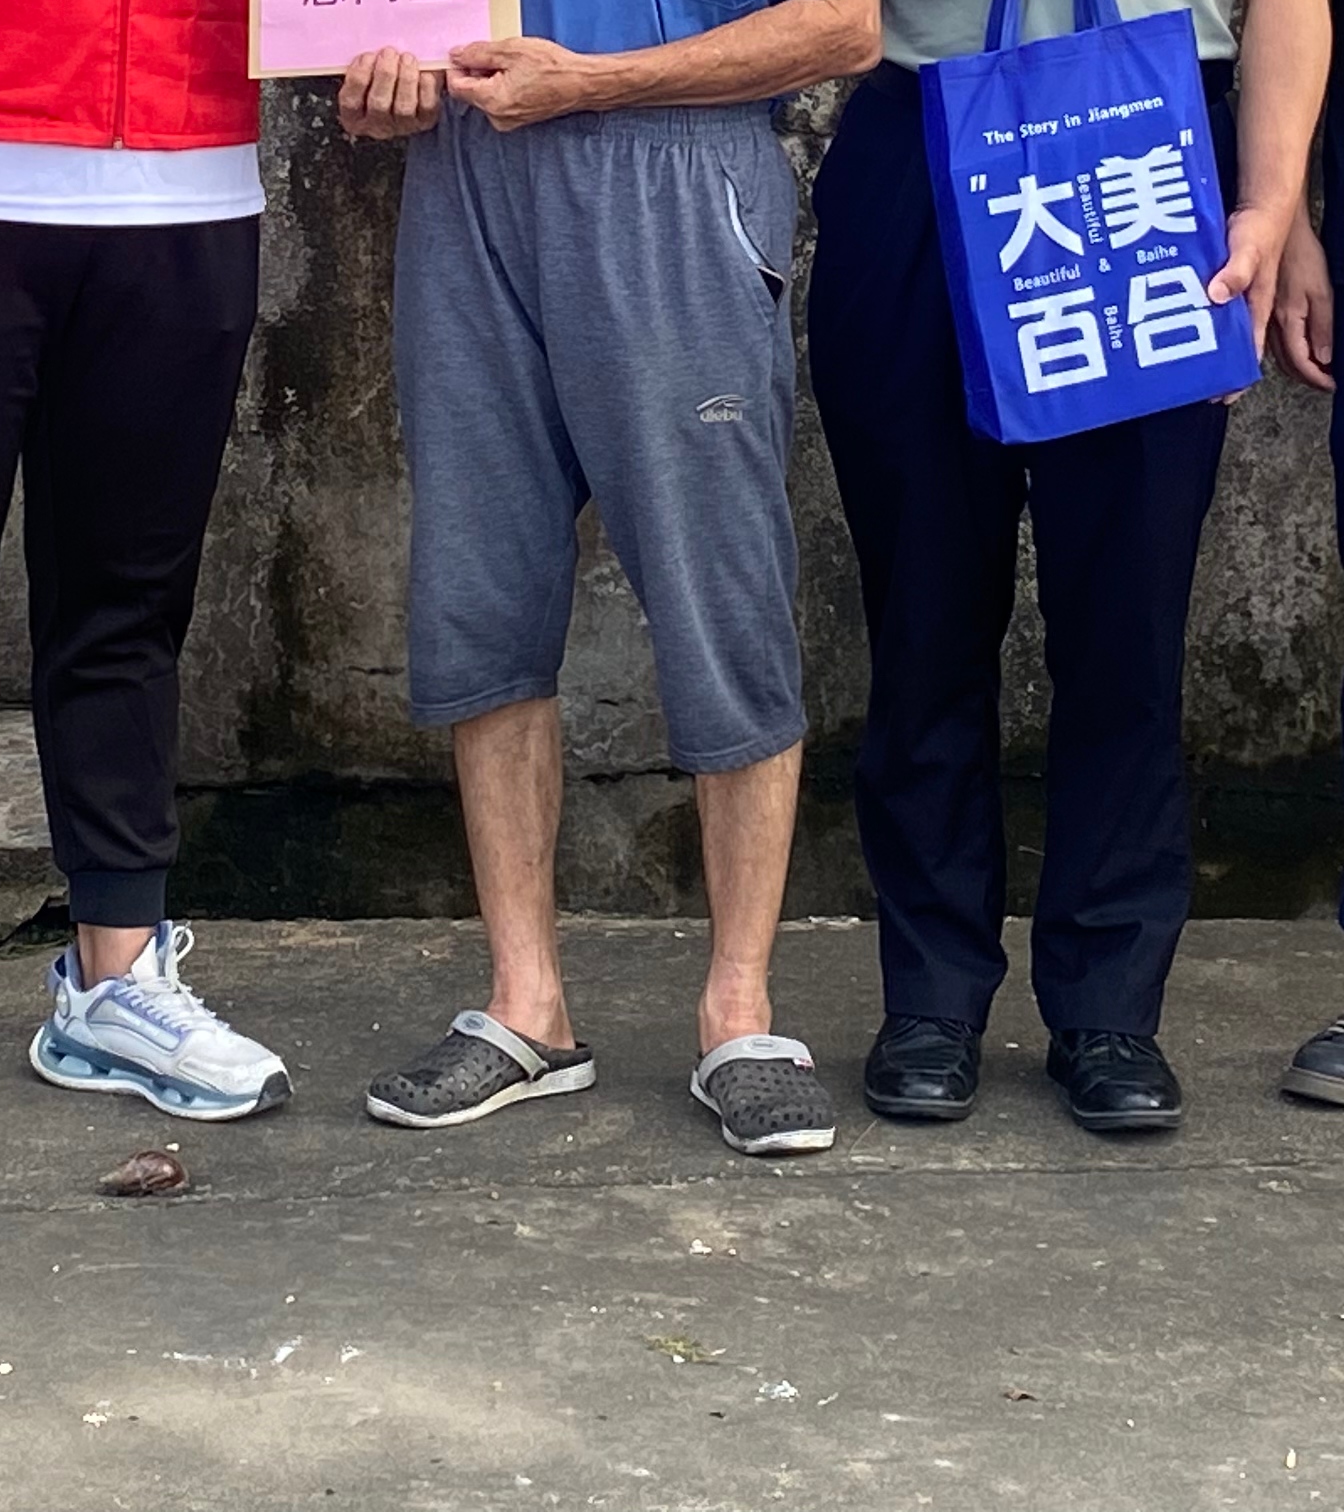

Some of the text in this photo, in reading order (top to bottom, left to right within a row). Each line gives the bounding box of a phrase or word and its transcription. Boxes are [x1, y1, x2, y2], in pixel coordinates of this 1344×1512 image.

[982, 95, 1164, 145] The Story in Jiangmen
[1076, 173, 1104, 244] Beautiful
[1013, 244, 1178, 292] Beautiful & Baihe
[1008, 265, 1218, 395] 百合
[1103, 305, 1124, 349] Baihe
